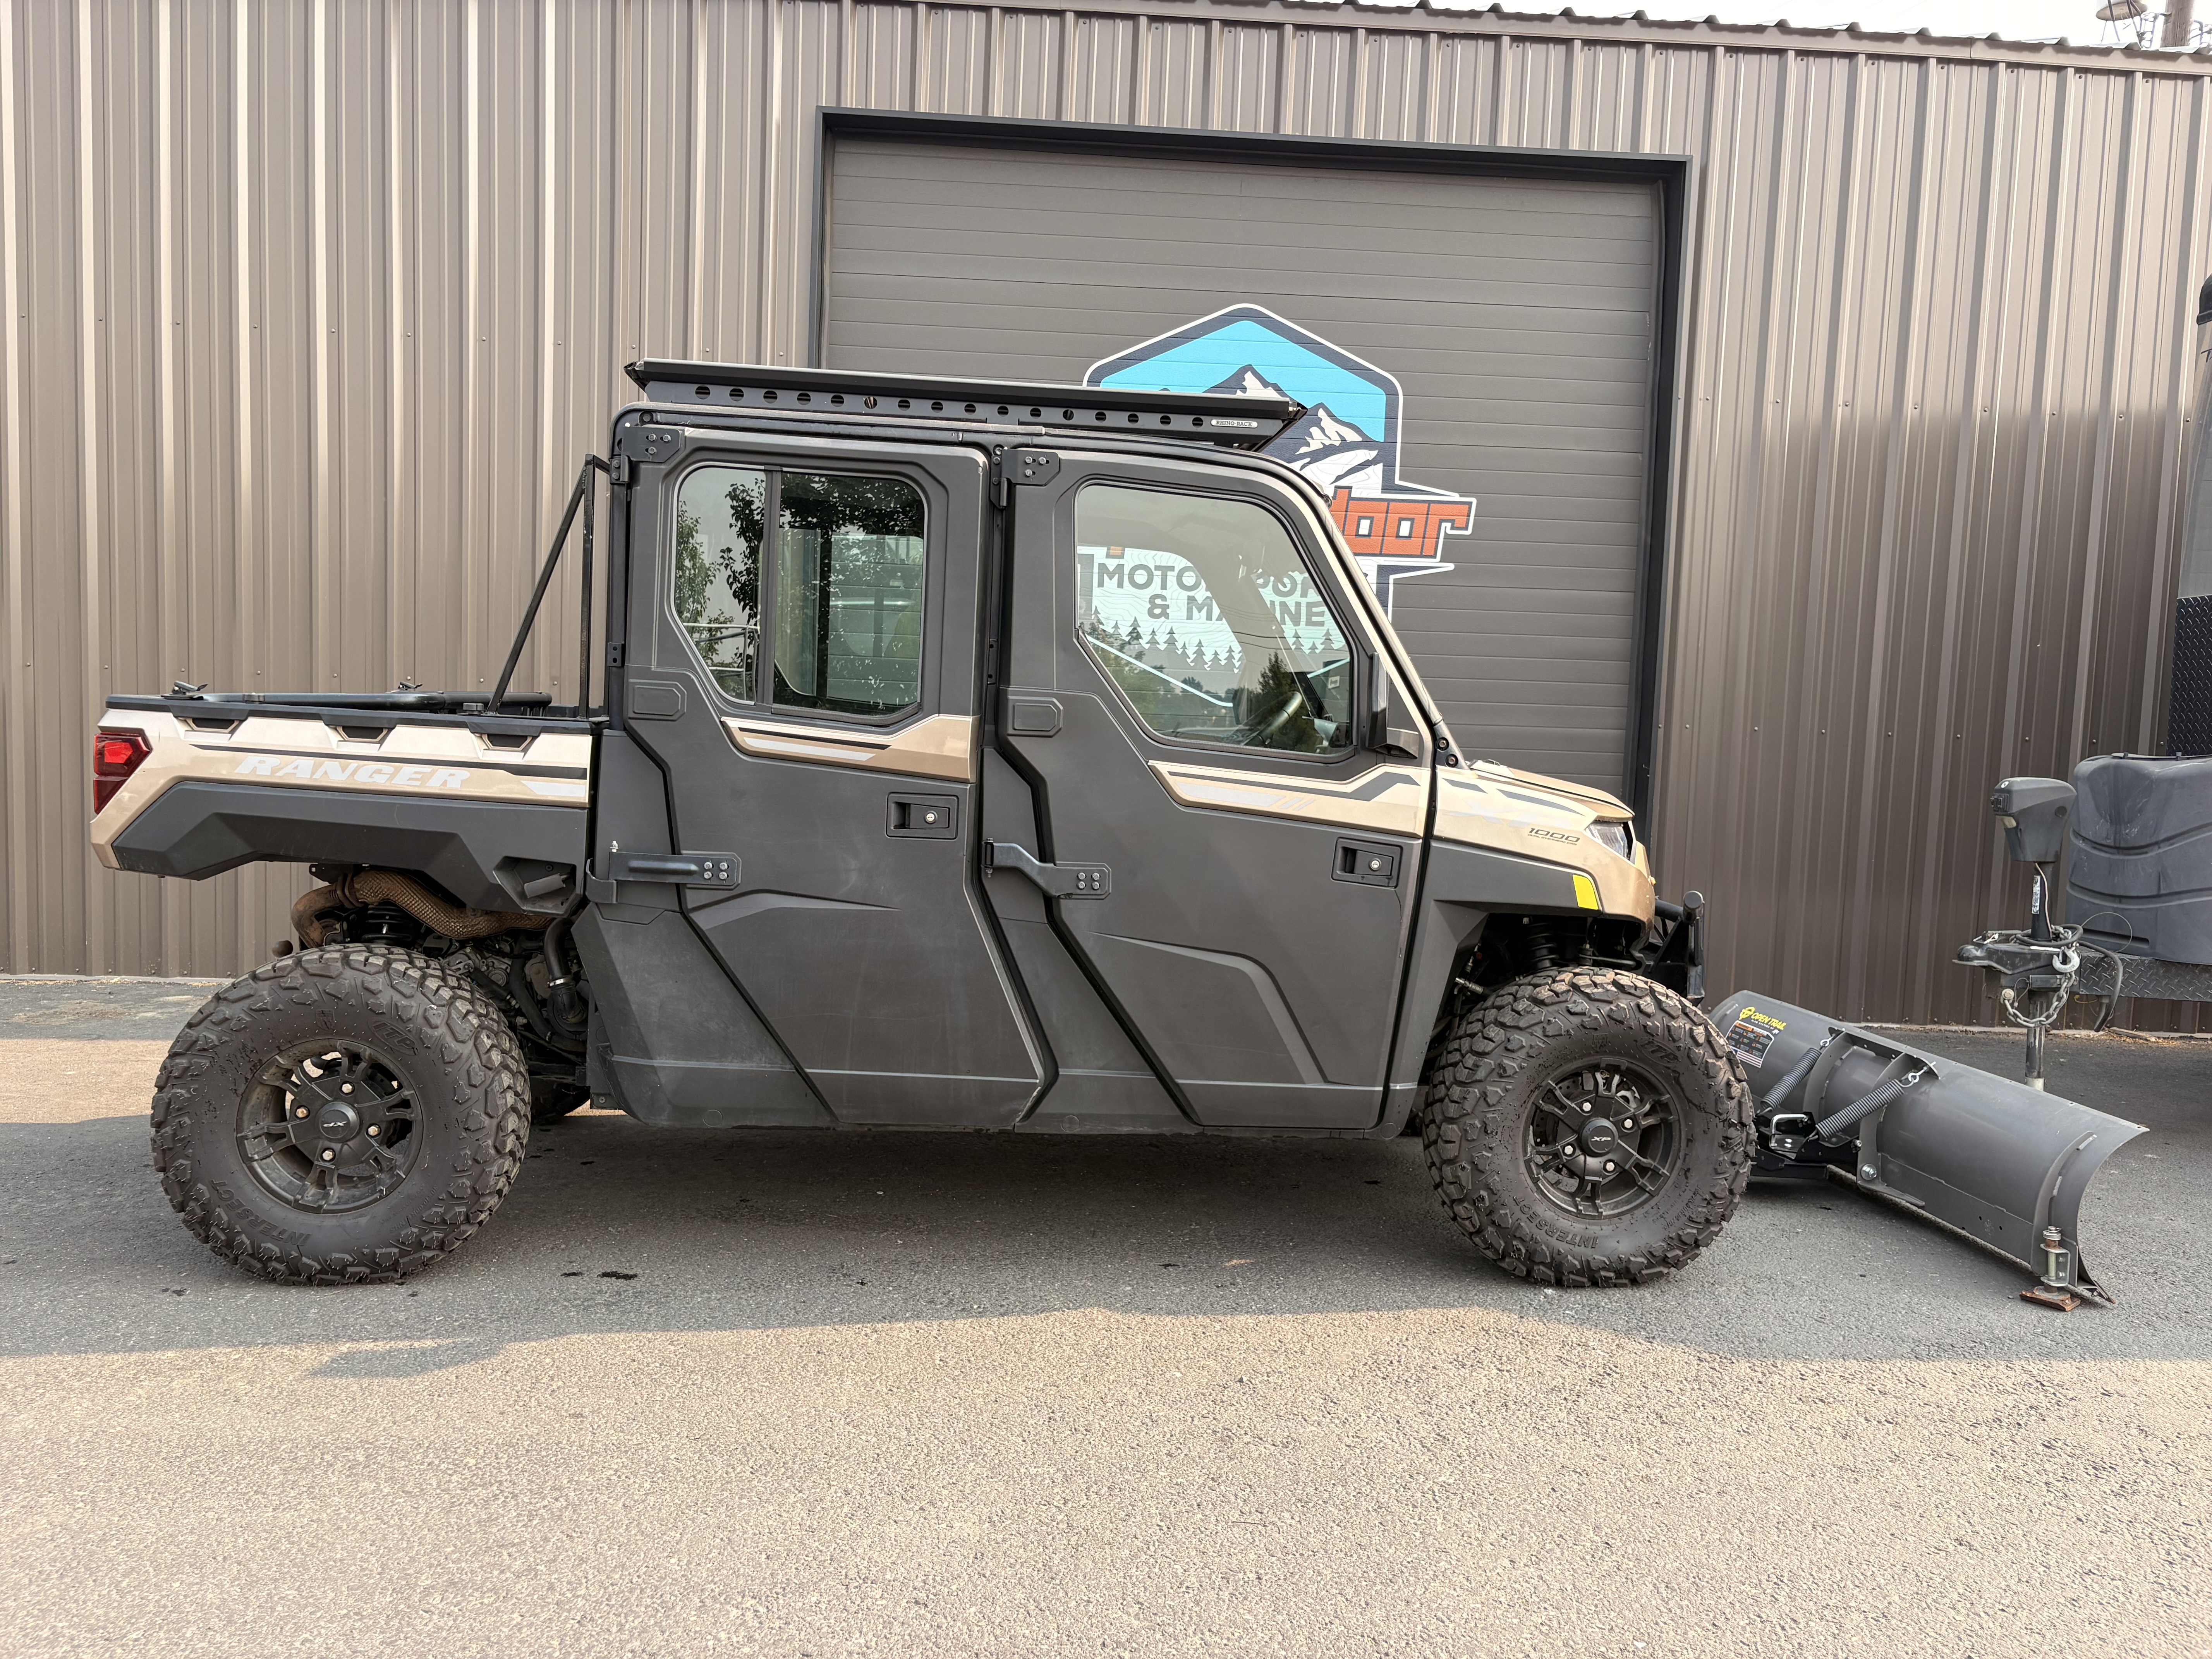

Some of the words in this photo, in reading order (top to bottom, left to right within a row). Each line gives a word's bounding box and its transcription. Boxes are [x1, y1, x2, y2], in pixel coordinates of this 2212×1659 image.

[1147, 593, 1170, 620] &
[1186, 595, 1326, 627] MINE
[235, 755, 470, 788] RANGER
[1528, 828, 1580, 842] 1000
[372, 1022, 416, 1049] ITP
[1751, 1012, 1771, 1024] OPEN
[1768, 1018, 1786, 1030] TRAIL
[210, 1180, 311, 1246] INTERSECT
[1512, 1195, 1599, 1249] INTERSECT
